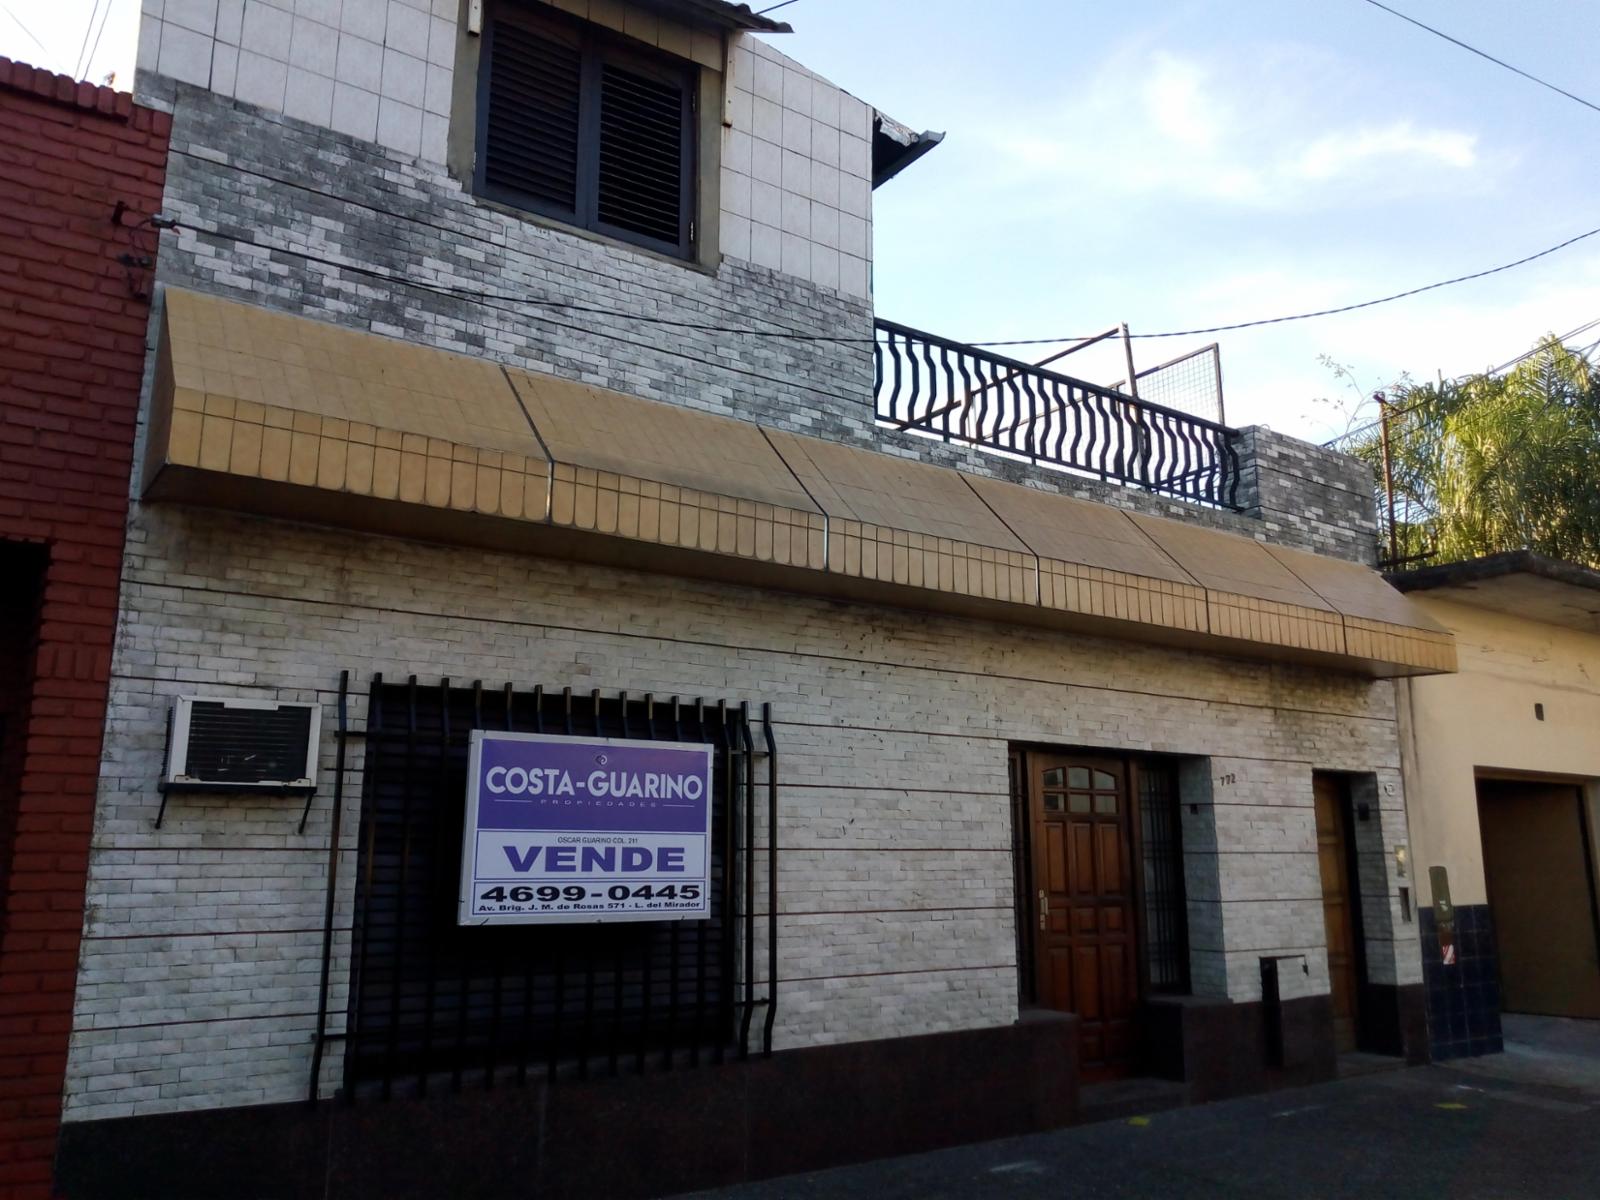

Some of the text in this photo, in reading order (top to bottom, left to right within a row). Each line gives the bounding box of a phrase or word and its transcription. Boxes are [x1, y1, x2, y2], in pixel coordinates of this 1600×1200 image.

[486, 766, 703, 800] COSTA-GUARINO
[1220, 772, 1236, 786] 772
[540, 799, 656, 807] PROPIEDADES
[557, 836, 581, 844] OSCAR
[502, 846, 685, 872] VENDE
[480, 885, 700, 902] 4699-0445
[499, 904, 525, 912] Brig.
[573, 902, 604, 910] Rosas
